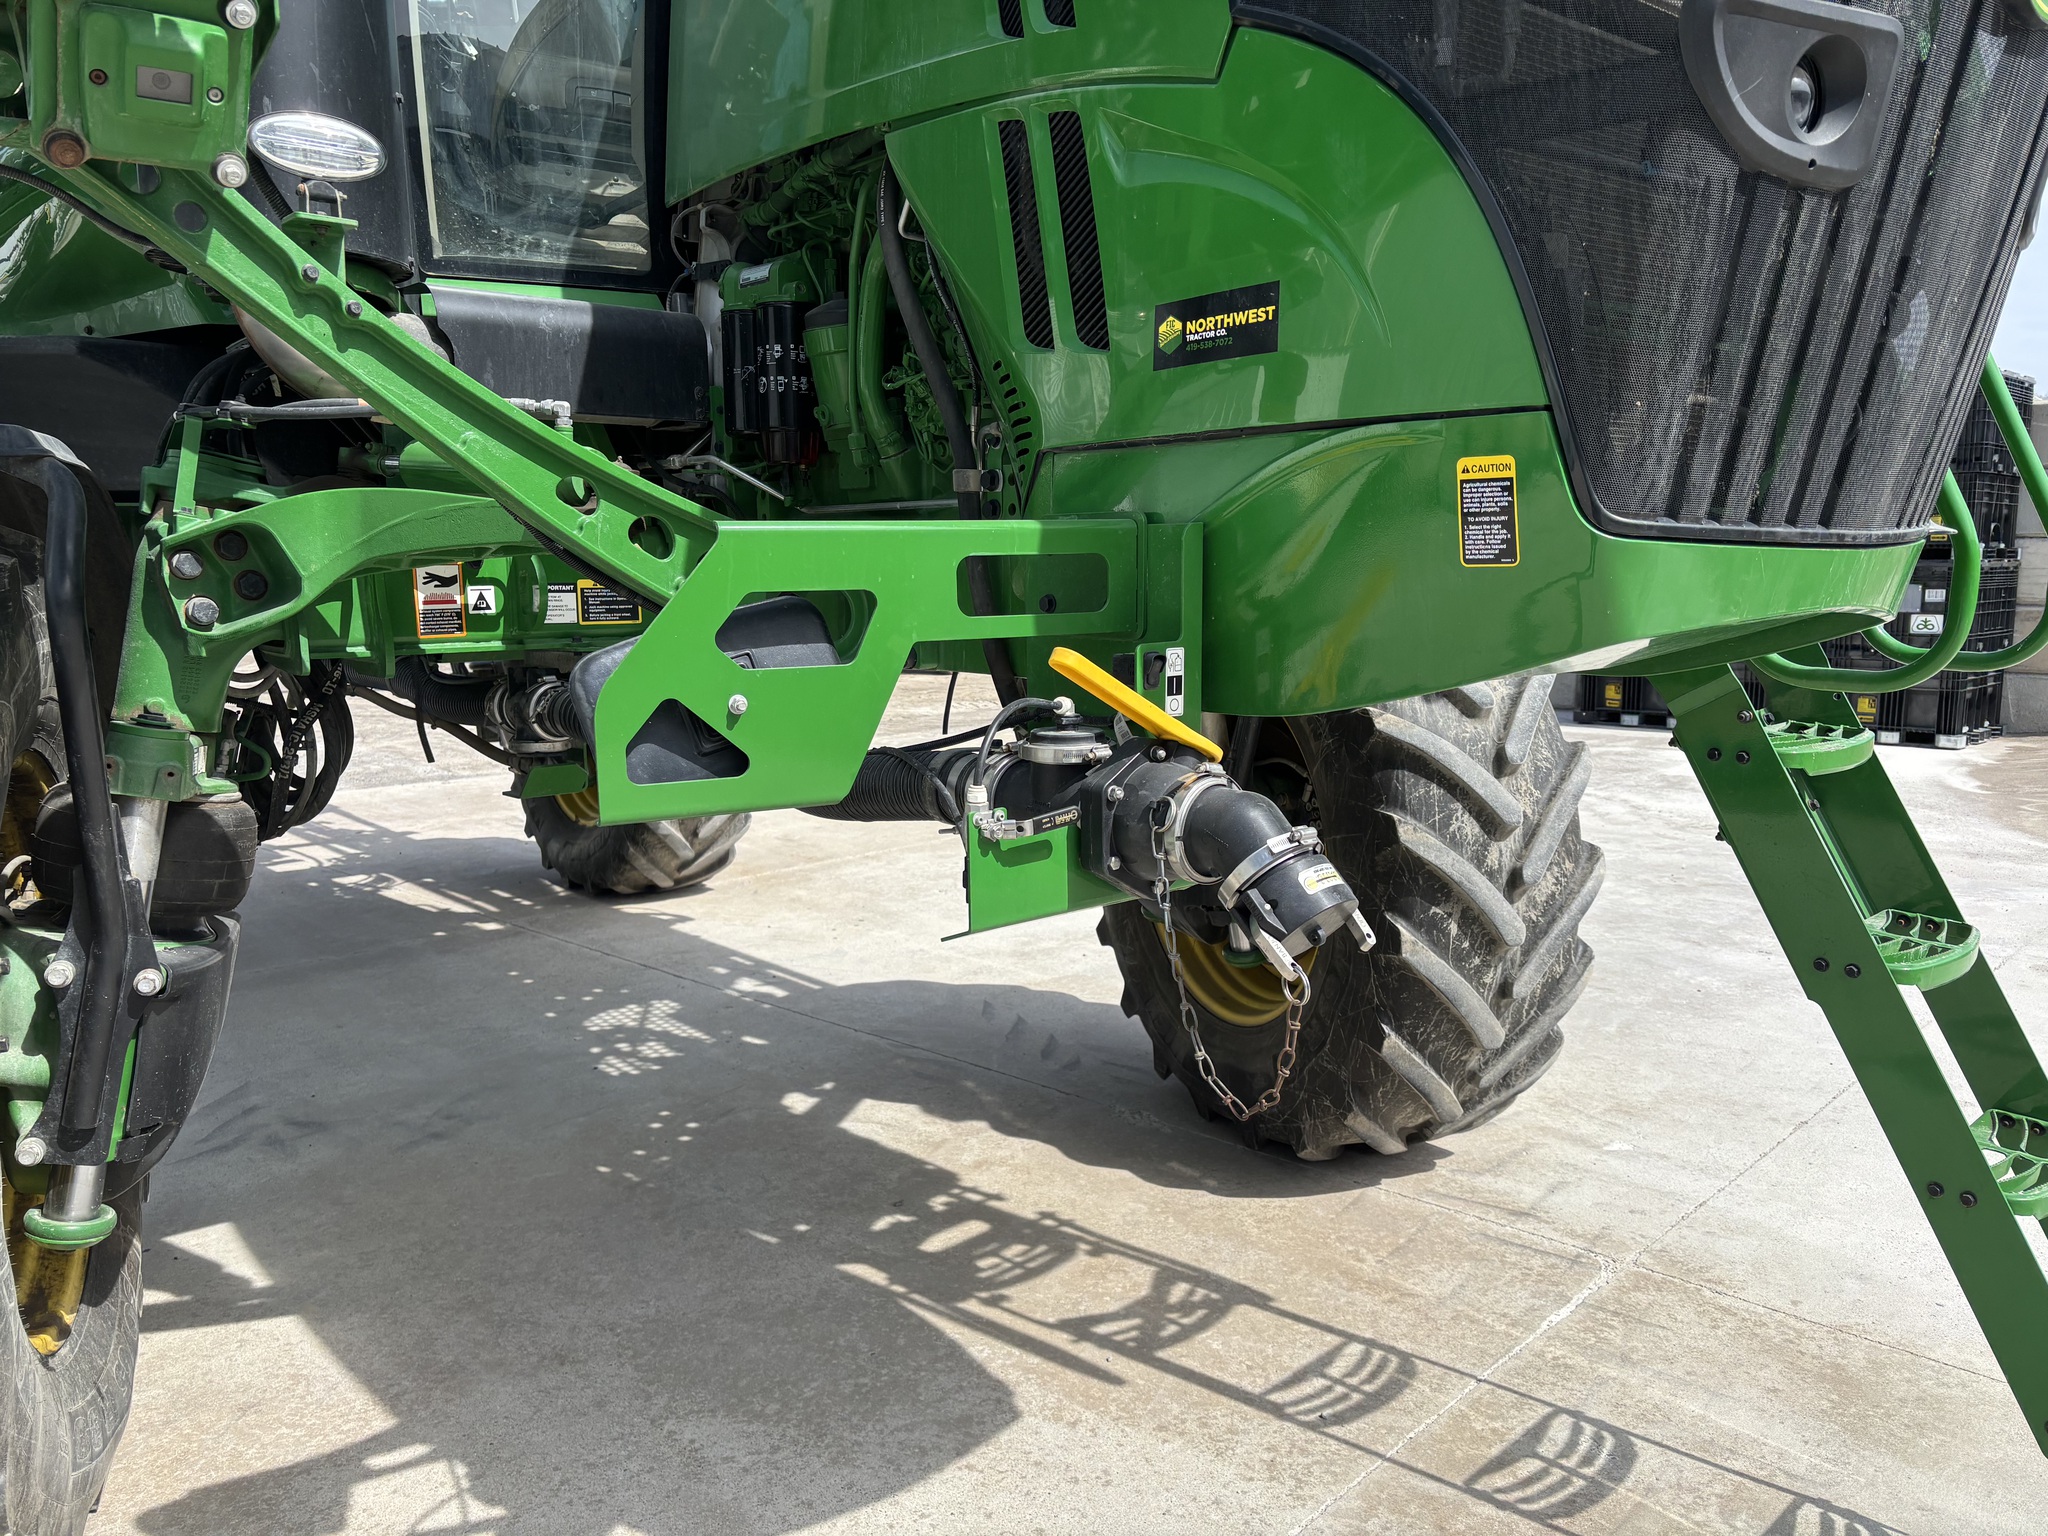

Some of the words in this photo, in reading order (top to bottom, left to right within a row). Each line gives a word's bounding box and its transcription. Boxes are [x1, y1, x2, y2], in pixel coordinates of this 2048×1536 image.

[1186, 305, 1276, 334] NORTHWEST
[1186, 330, 1215, 342] TRACTOR
[1216, 328, 1228, 337] CO.
[1186, 337, 1233, 352] 419-538-7072
[1471, 463, 1511, 474] CAUTION
